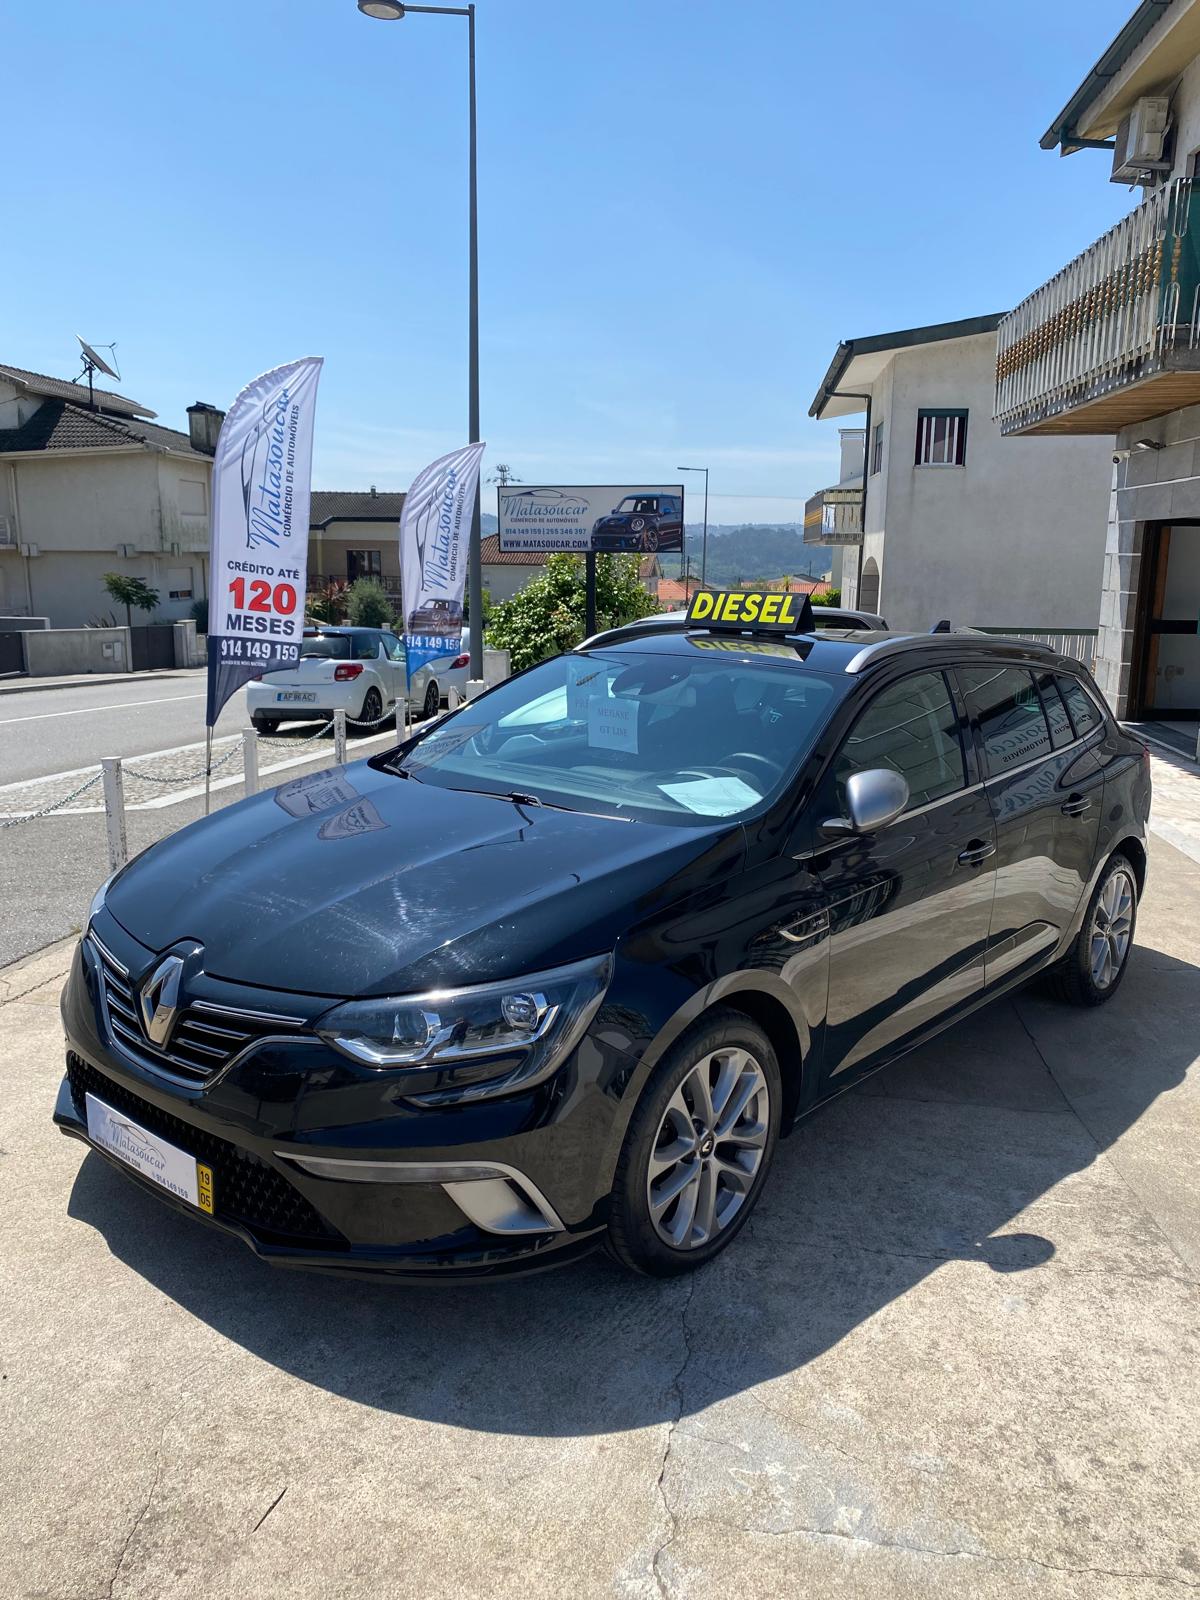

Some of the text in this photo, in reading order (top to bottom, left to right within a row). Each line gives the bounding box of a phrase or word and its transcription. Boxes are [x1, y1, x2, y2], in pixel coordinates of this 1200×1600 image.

[250, 387, 290, 550] Matasoucar
[283, 404, 300, 538] COMÉRCIO DE AUTOMÓVEIS
[501, 496, 588, 517] Matasoucar
[423, 468, 456, 592] Matasoucar
[449, 482, 466, 582] COMÉRCIO DE AUTOMÓVEIS
[503, 540, 589, 548] WWW.MATASOUCAR.COM
[227, 560, 300, 580] CRÉDITO ATÉ
[229, 576, 297, 615] 120
[690, 592, 796, 624] DIESEL
[226, 613, 296, 636] MESES
[221, 639, 299, 661] 914 149 159
[424, 636, 442, 649] 149
[444, 638, 460, 650] 159
[110, 1121, 166, 1171] Matasoucar
[200, 1170, 211, 1186] 19
[200, 1192, 212, 1208] 05
